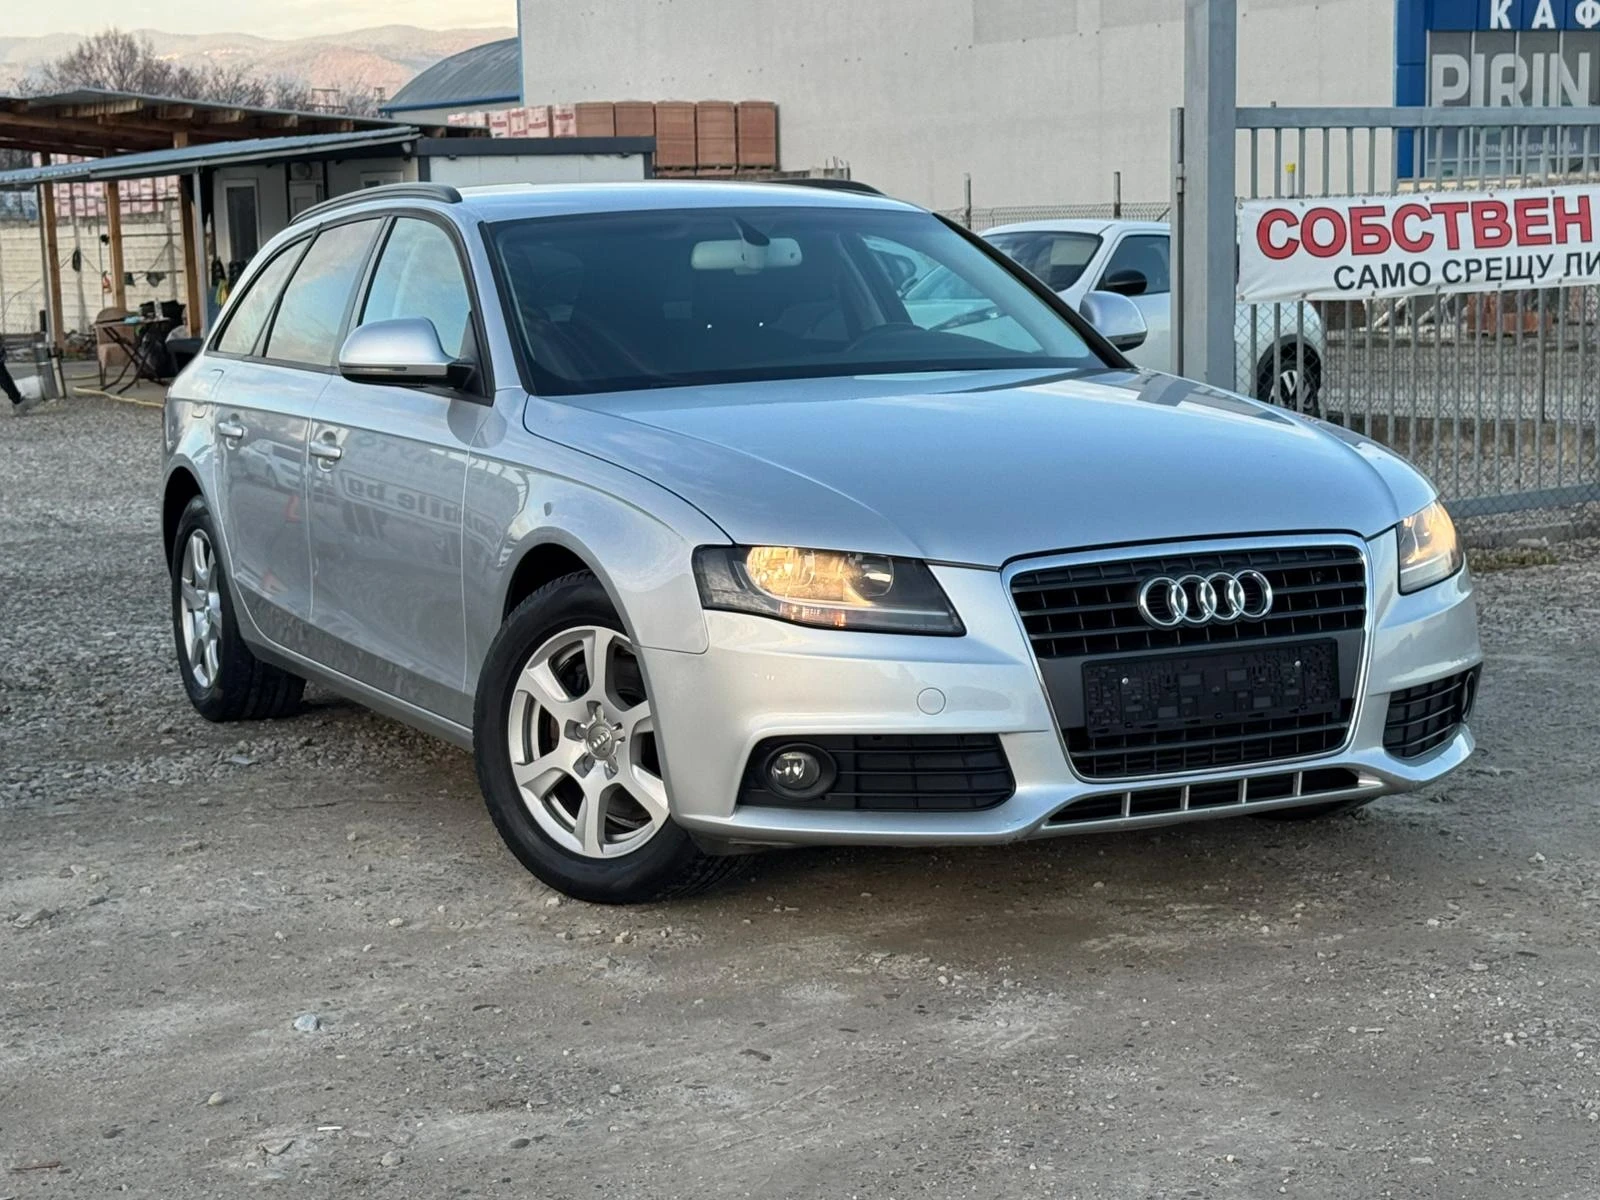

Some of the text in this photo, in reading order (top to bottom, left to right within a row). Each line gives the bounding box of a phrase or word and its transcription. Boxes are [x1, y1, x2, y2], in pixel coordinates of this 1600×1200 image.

[1431, 53, 1590, 107] PIRIN
[1256, 195, 1592, 260] СОБСТВЕН
[1333, 261, 1431, 290] САМО
[1442, 254, 1554, 284] СРЕЩУ
